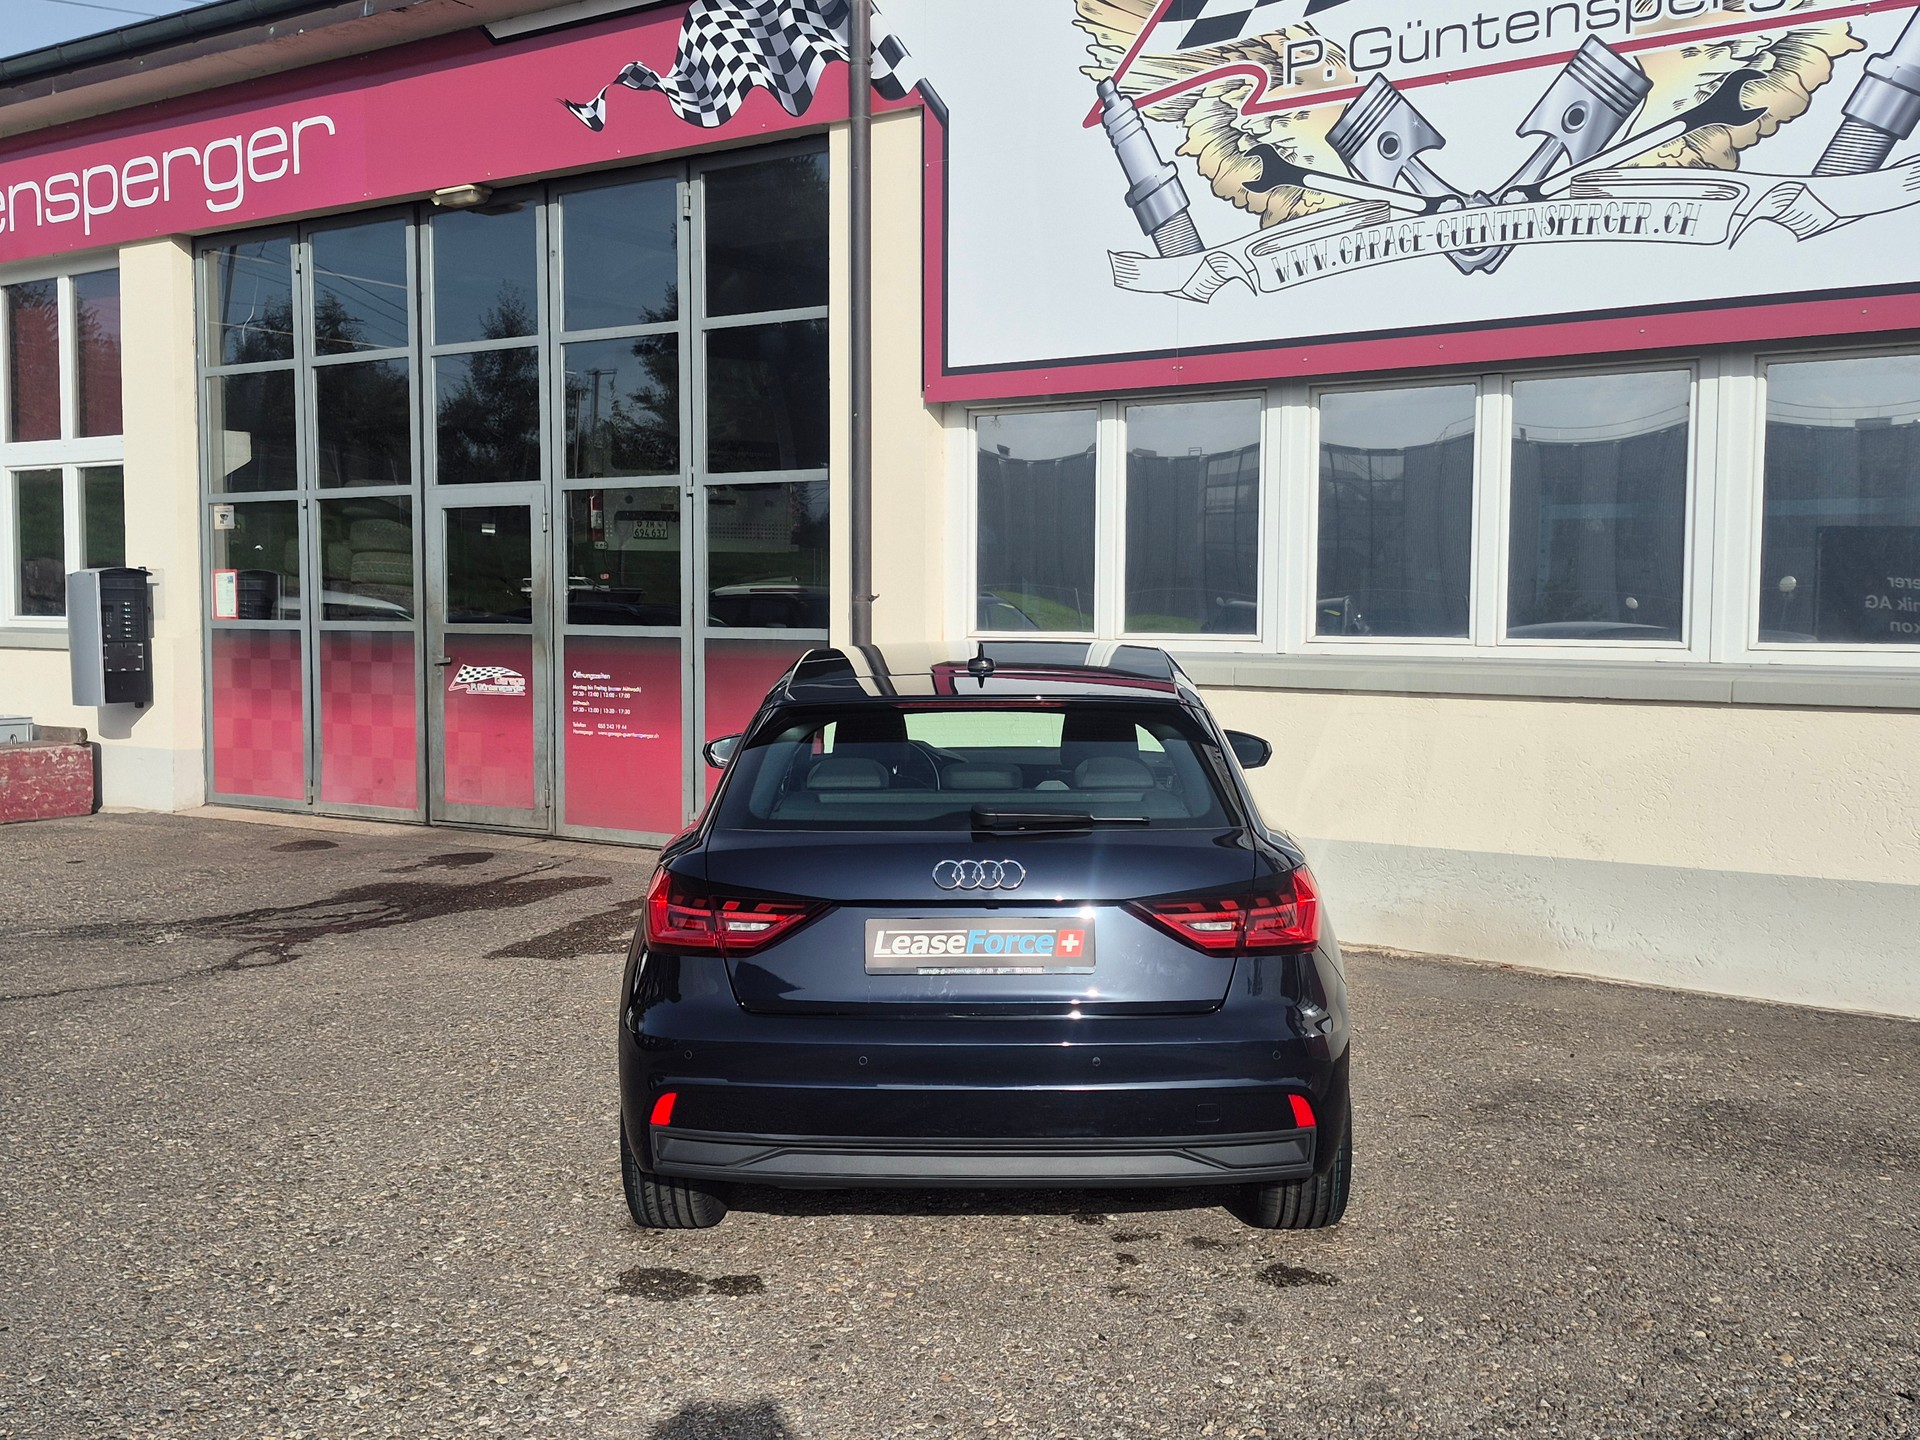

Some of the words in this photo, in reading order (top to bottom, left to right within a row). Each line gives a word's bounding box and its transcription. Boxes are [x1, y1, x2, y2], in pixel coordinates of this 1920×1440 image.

[0, 115, 336, 236] nsperger
[1271, 201, 1703, 284] WWW.GARAGE-GUENTENSPERGER.CH
[874, 929, 1054, 955] LeaseForce
